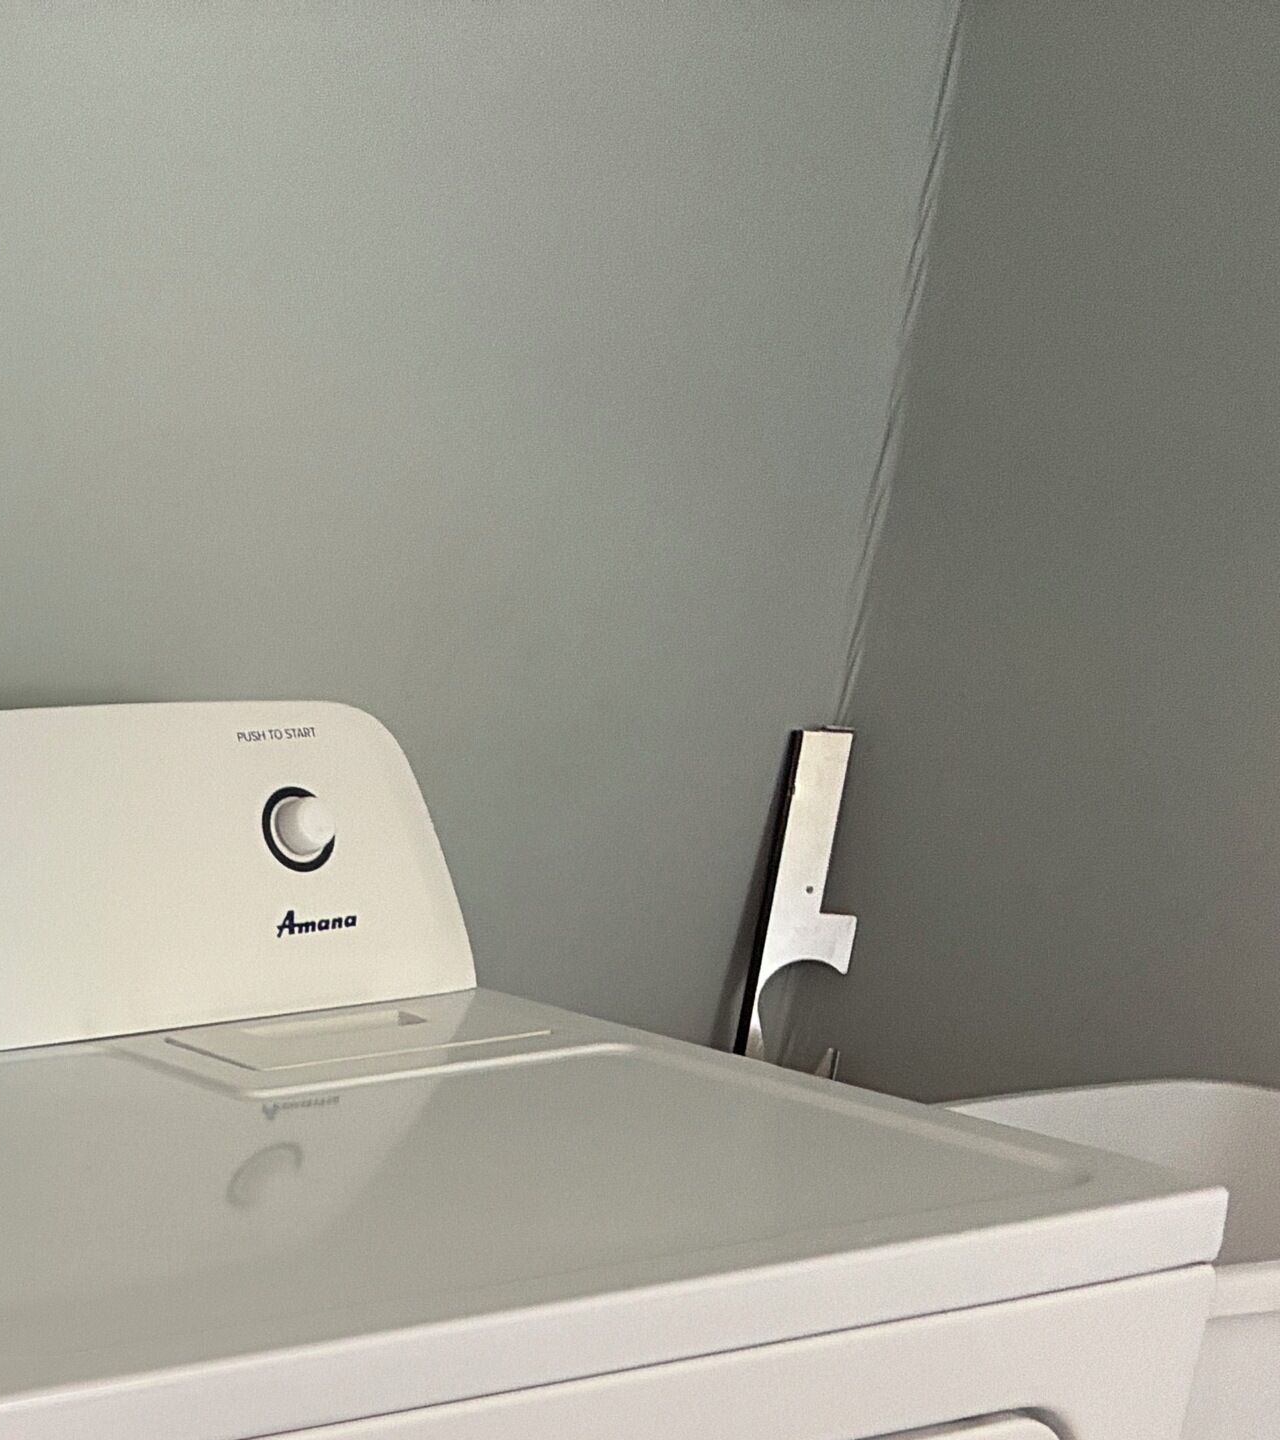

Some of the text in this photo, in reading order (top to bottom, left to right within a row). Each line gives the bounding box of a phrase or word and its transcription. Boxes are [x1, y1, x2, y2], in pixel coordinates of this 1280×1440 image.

[237, 727, 316, 742] PUSH TO START
[277, 910, 357, 938] Amana
